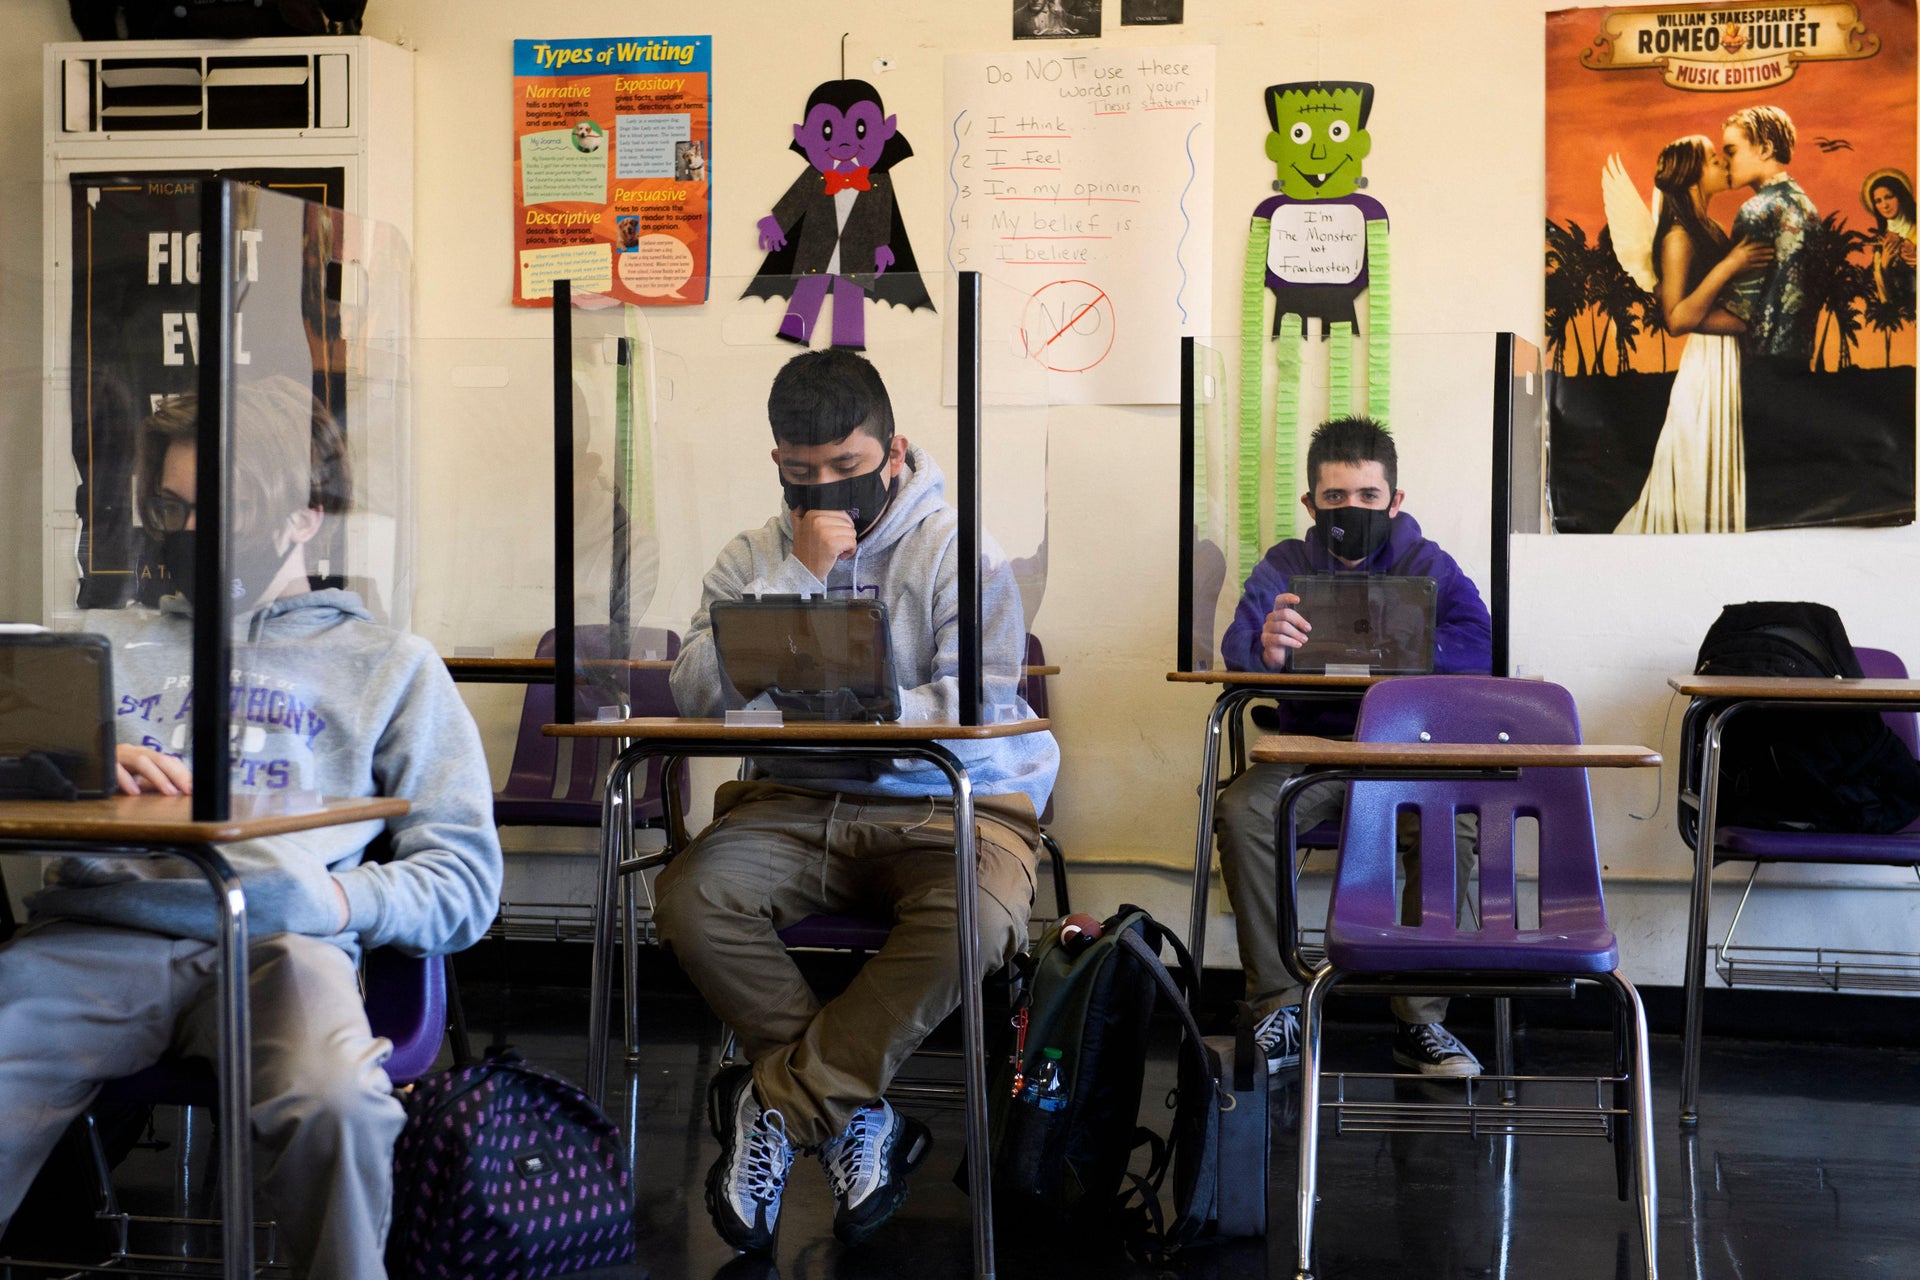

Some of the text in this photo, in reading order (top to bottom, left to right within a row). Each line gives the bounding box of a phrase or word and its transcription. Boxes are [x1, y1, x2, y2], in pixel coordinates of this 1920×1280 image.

[1657, 8, 1806, 28] WILLIAM SHAKESPEARE'S
[1638, 23, 1820, 54] ROMEO JULIET
[533, 41, 695, 69] Types of Writing
[987, 57, 1190, 84] Do NOT use these
[1676, 61, 1782, 86] MUSIC EDITION
[526, 84, 591, 98] Narrative
[615, 76, 685, 93] Expository
[1060, 81, 1184, 101] words in your
[526, 101, 540, 109] tells
[549, 102, 565, 110] story
[615, 94, 633, 103] gives
[655, 93, 684, 103] explains
[526, 110, 590, 120] beginning, middle,
[988, 116, 1005, 134] I
[962, 154, 971, 169] 2
[986, 149, 1007, 165] I
[148, 183, 195, 197] MICAH
[615, 188, 687, 202] Persuasive
[961, 179, 1141, 206] 3 In my opinion
[640, 204, 670, 212] convince
[672, 204, 683, 212] the
[526, 210, 601, 227] Descriptive
[675, 214, 702, 223] support
[961, 213, 969, 229] 4
[991, 210, 1020, 240] My
[1034, 211, 1100, 233] belief
[1304, 211, 1333, 223] I'm
[526, 236, 546, 245] place,
[548, 236, 568, 245] thing,
[566, 228, 592, 236] person,
[1276, 227, 1358, 242] The Monster
[957, 247, 968, 265] 5
[996, 244, 1014, 260] I
[1039, 300, 1101, 337] NO
[162, 312, 251, 366] EL
[117, 693, 163, 724] ST.
